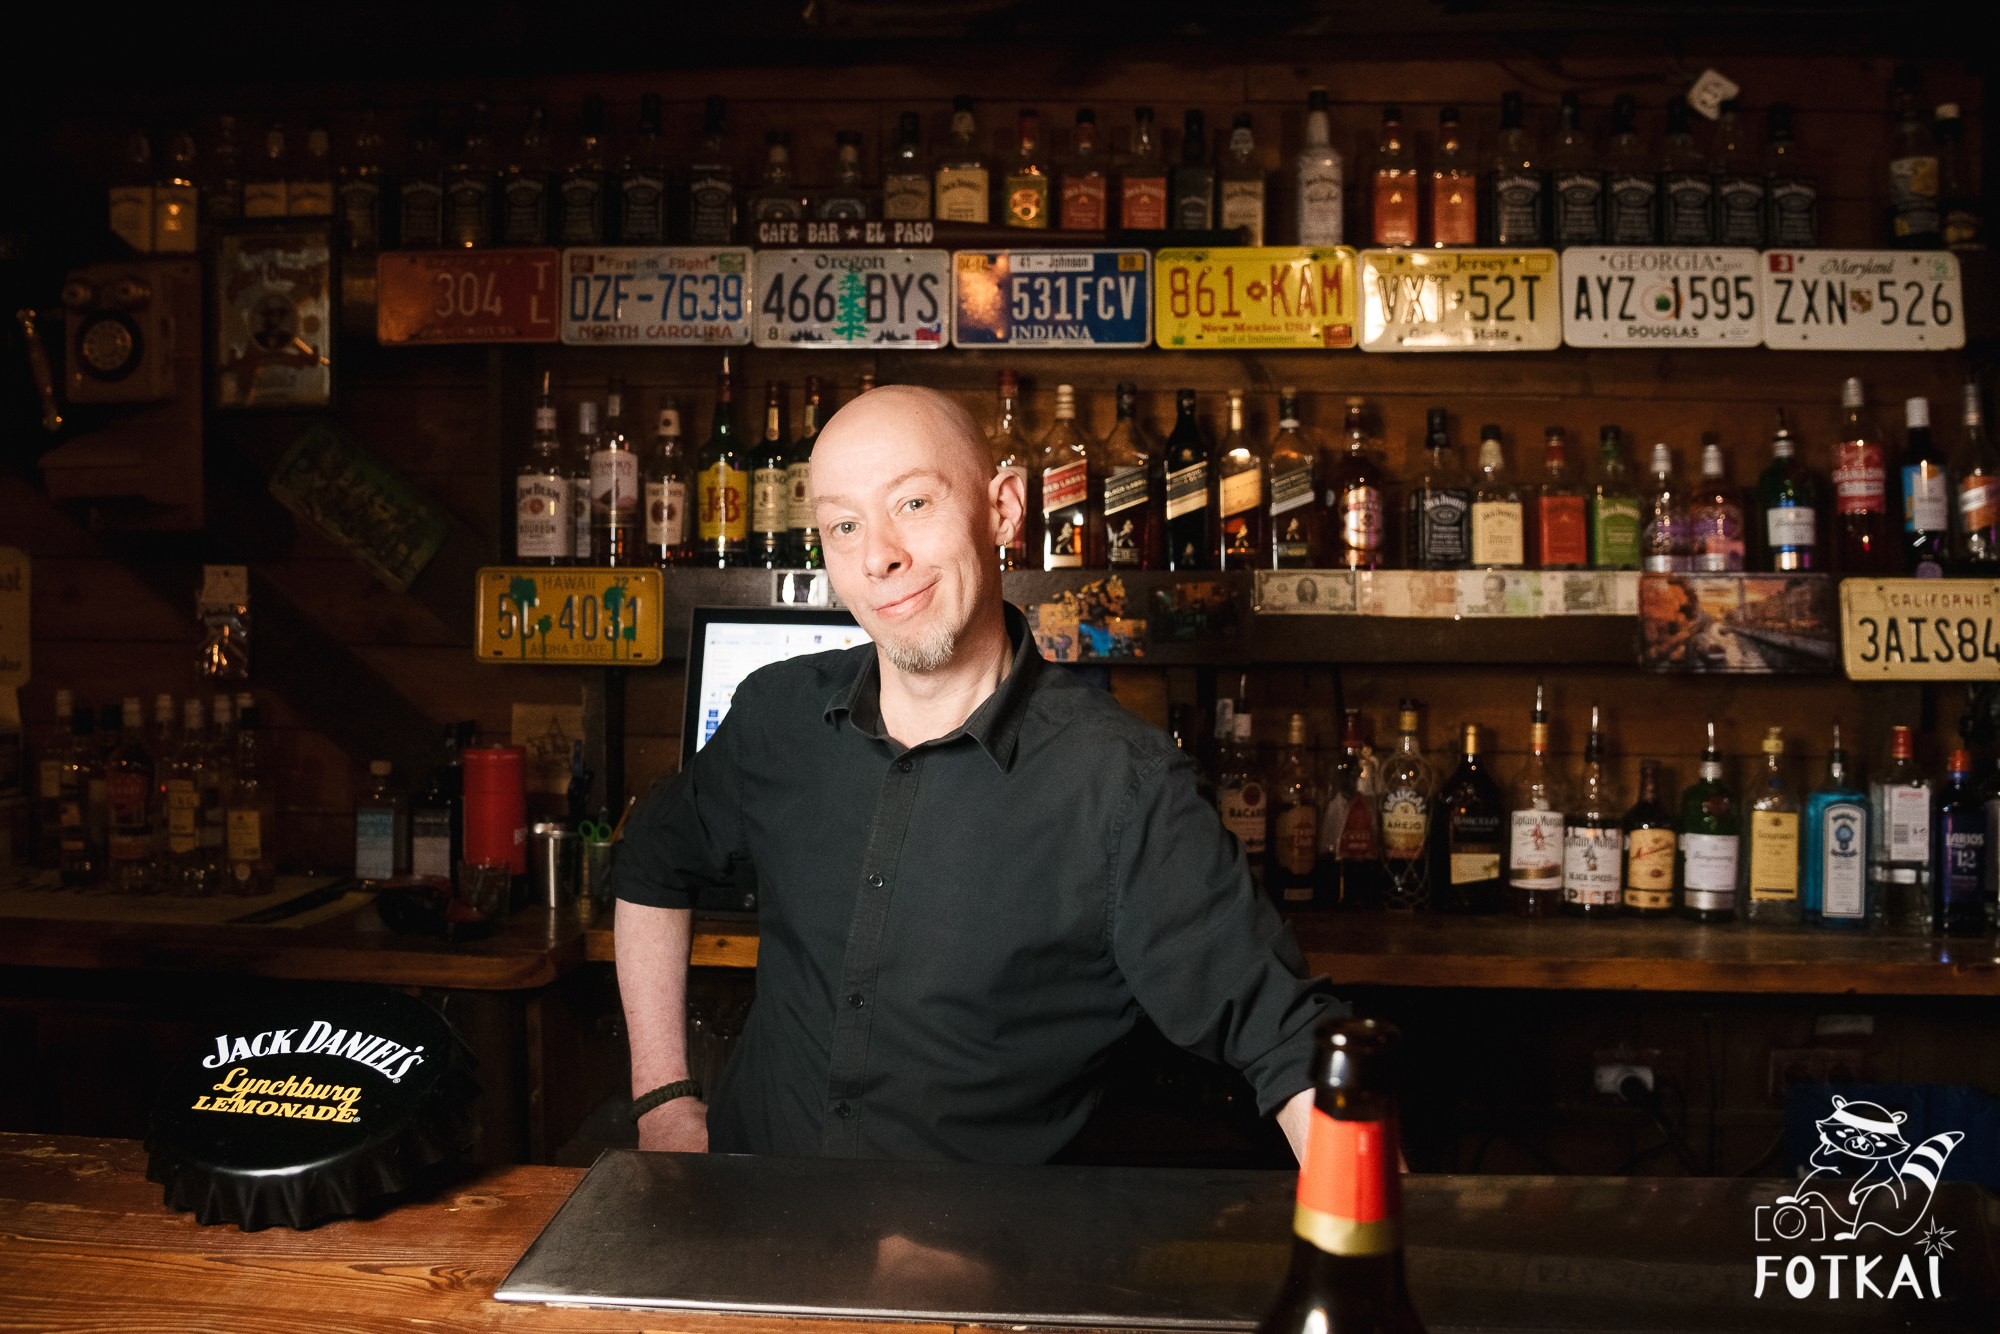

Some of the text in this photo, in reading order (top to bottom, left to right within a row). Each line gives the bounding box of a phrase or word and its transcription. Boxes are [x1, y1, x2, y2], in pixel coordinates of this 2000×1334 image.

[759, 222, 934, 243] CAFE BAR EL PASO
[815, 253, 885, 271] Oregon
[1608, 252, 1717, 271] GEORGIA
[1819, 255, 1895, 280] Maryland
[436, 272, 503, 318] 304
[569, 275, 743, 321] DZF-7639
[763, 272, 939, 324] 466 BYS
[1011, 275, 1136, 322] 531FCV
[1169, 264, 1343, 318] 861 KAM
[1469, 274, 1541, 323] 52T
[1574, 275, 1754, 321] AYZ 1595
[1774, 280, 1953, 326] ZXN 526
[578, 325, 733, 339] NORTH CAROLINA
[1011, 325, 1093, 340] INDIANA
[1627, 325, 1699, 339] DOUGLAS
[542, 576, 596, 589] HAWAII
[1890, 593, 1993, 607] CALIFORNIA
[559, 594, 637, 641] 4031
[203, 1020, 424, 1080] JACK DANIEL'S
[191, 1096, 358, 1124] LEMONADE
[213, 1067, 362, 1110] Lynchburg
